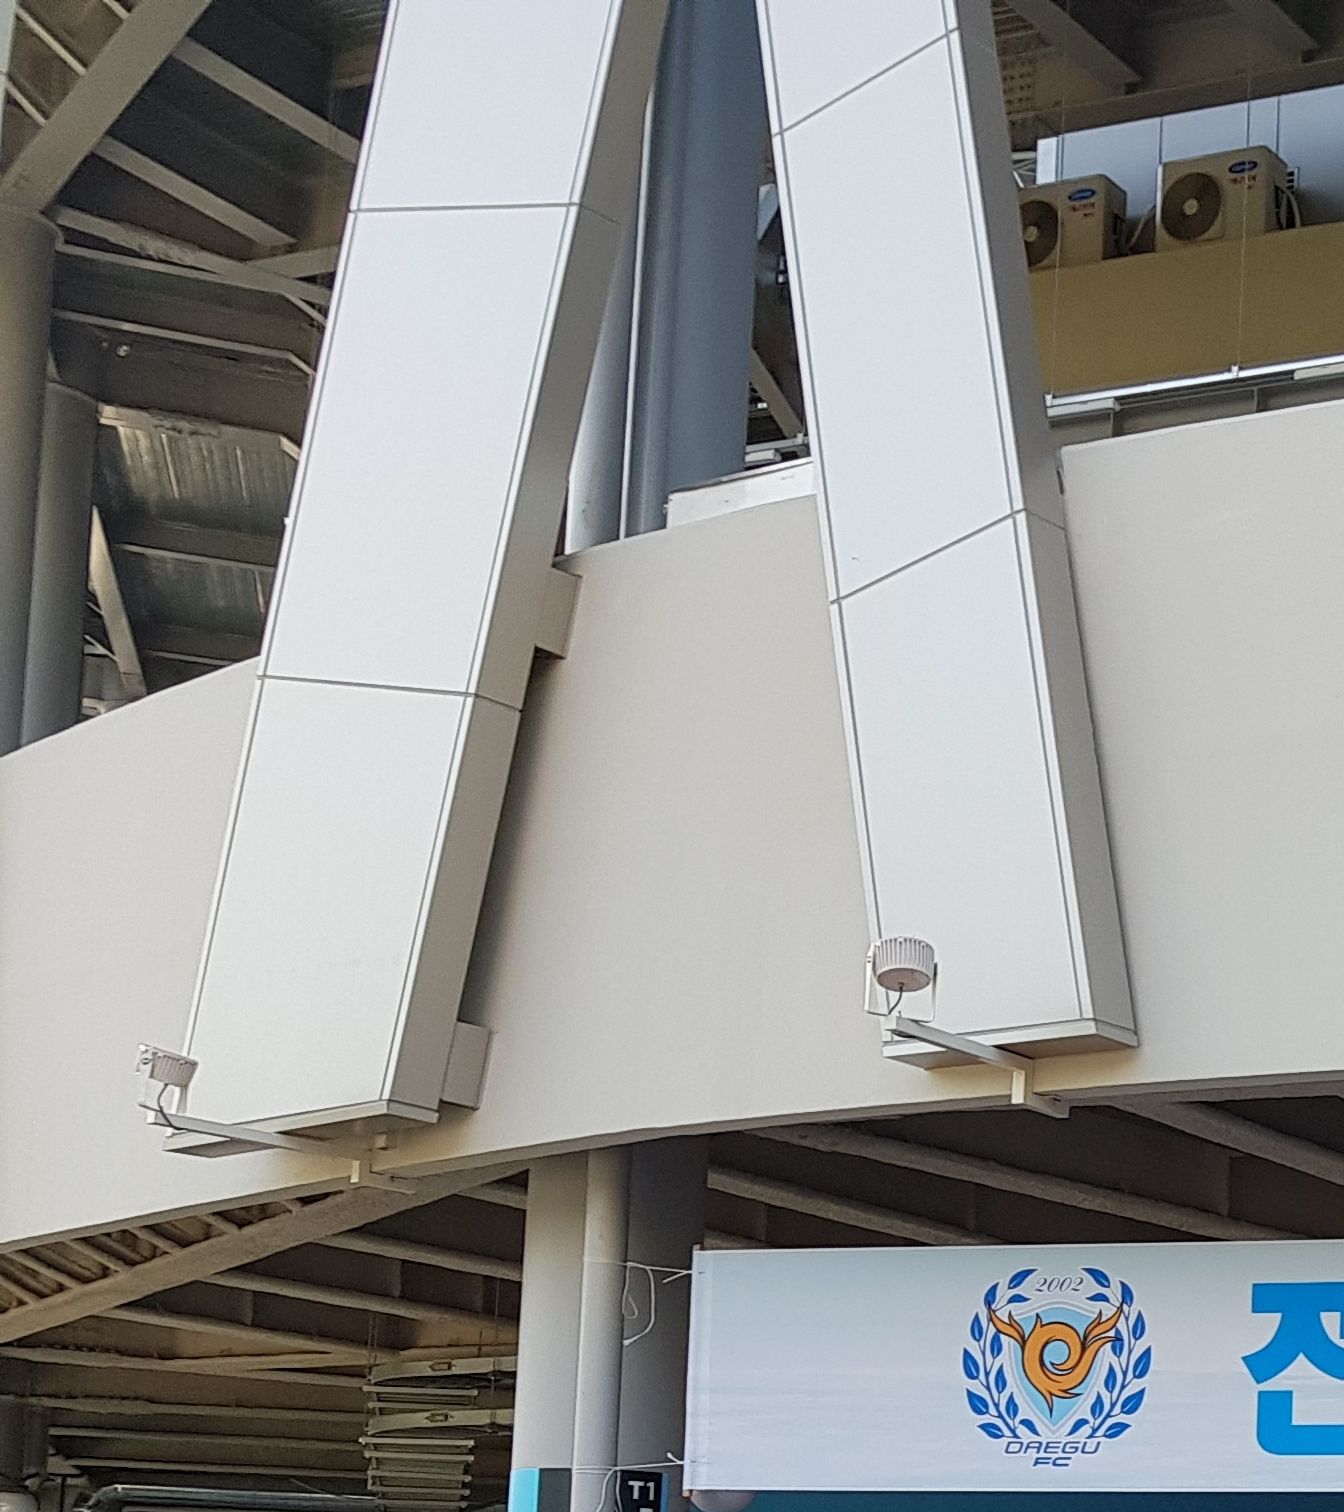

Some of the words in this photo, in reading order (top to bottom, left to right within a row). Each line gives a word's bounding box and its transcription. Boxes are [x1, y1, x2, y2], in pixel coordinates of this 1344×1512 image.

[1034, 1276, 1085, 1293] 2002
[1004, 1440, 1101, 1455] DAEGU
[1033, 1456, 1073, 1468] FC
